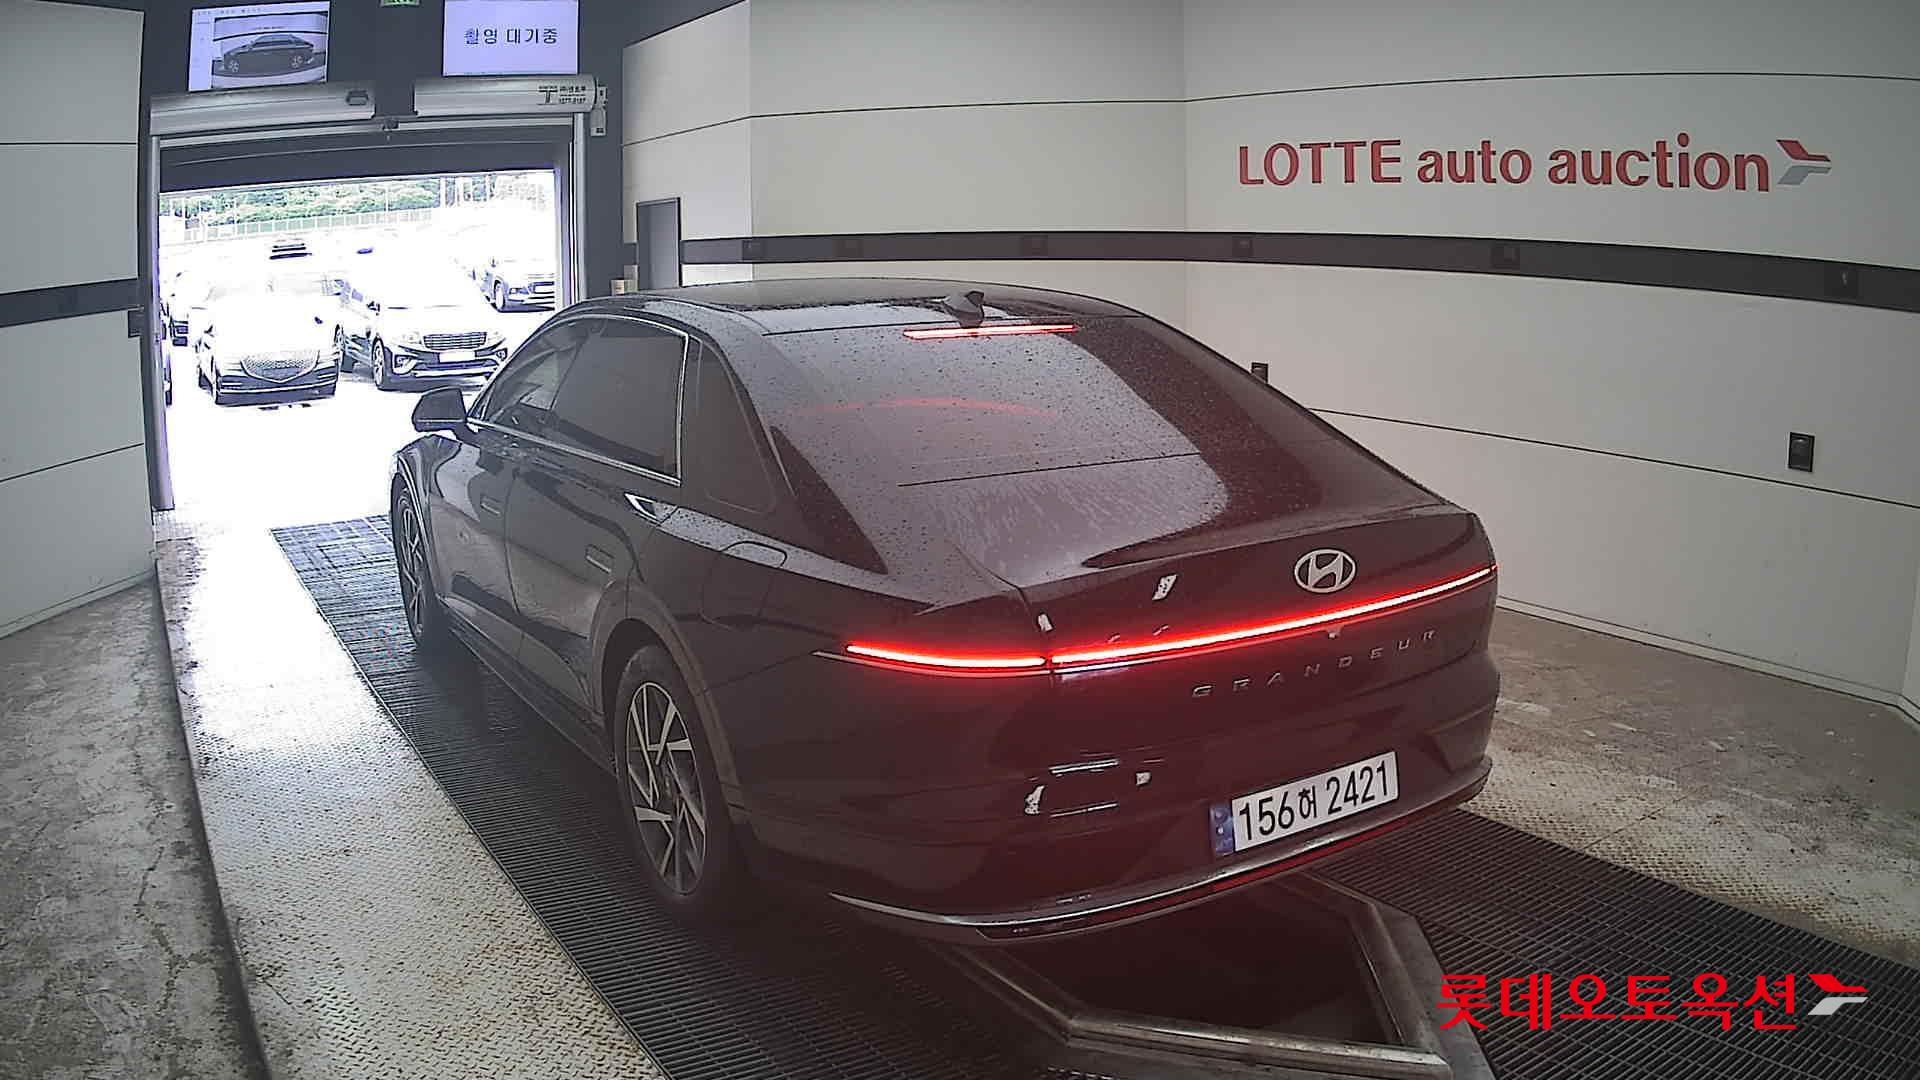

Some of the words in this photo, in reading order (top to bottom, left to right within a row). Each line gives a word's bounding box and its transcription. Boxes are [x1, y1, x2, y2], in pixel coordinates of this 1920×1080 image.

[506, 28, 558, 45] 대기중
[1239, 139, 1401, 186] LOTTE
[1417, 140, 1533, 185] auto
[1548, 132, 1770, 192] auction
[1192, 629, 1437, 697] GRANDEUR
[1239, 785, 1318, 841] 156허
[1326, 760, 1389, 816] 2421
